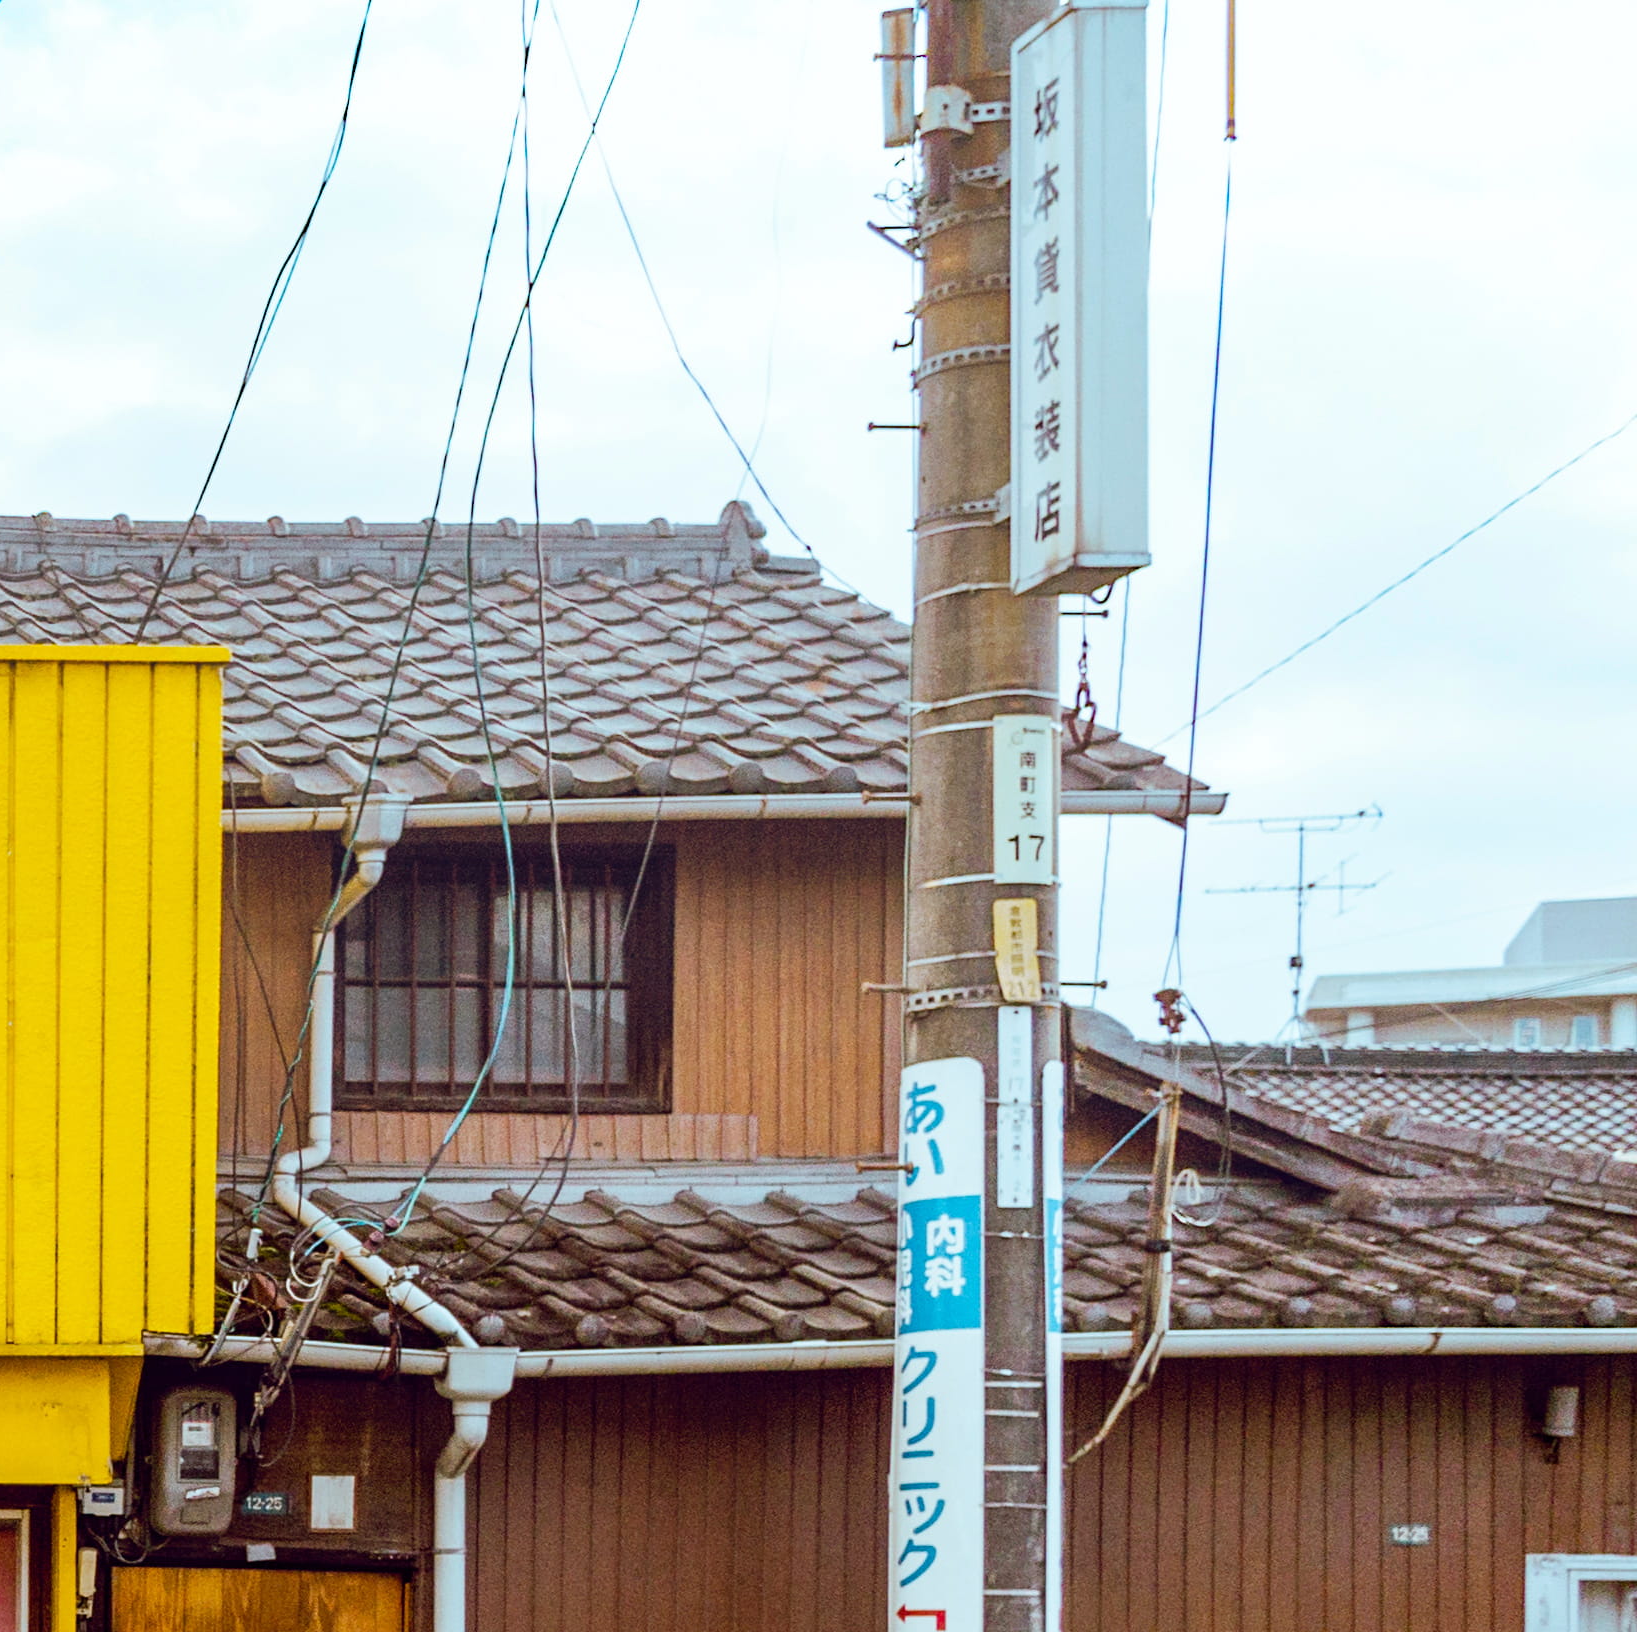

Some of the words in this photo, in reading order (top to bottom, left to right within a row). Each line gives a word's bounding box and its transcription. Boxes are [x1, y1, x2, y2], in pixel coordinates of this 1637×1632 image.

[1007, 834, 1046, 862] 17
[924, 1213, 966, 1298] 内科
[898, 1345, 946, 1589] クリニック
[245, 1496, 283, 1511] 12-25
